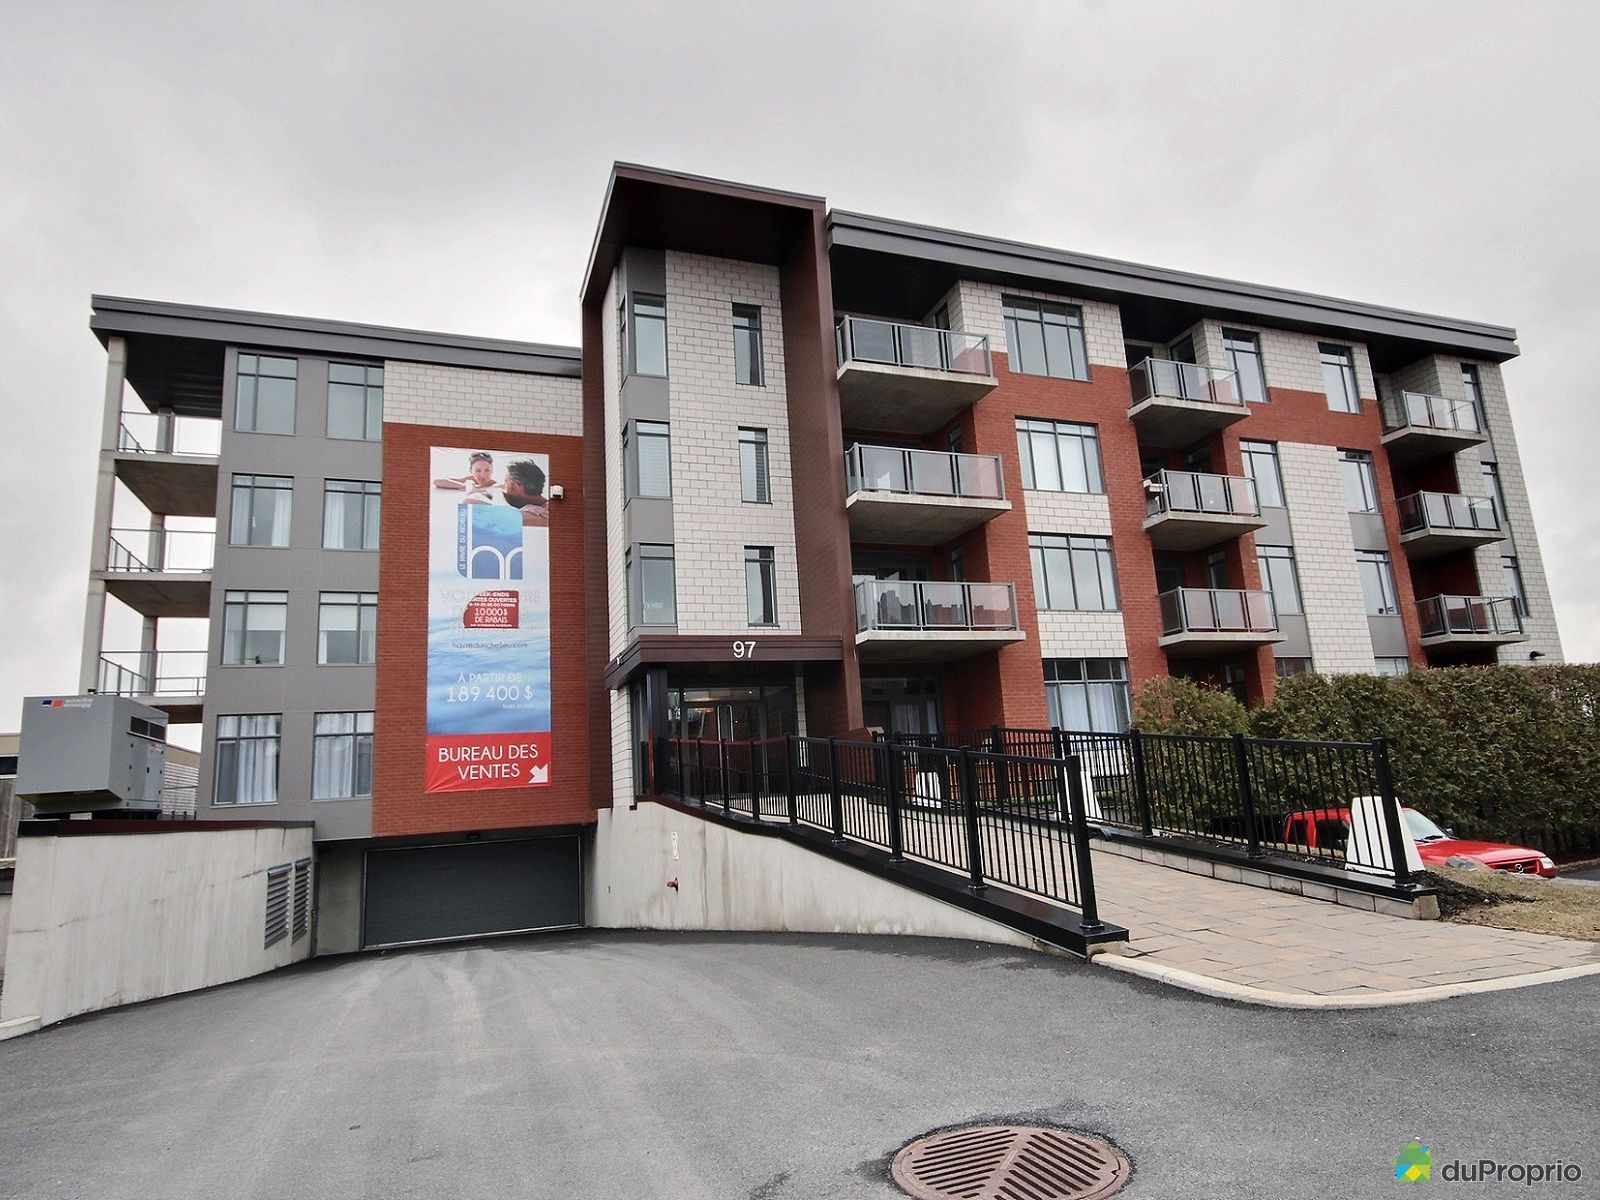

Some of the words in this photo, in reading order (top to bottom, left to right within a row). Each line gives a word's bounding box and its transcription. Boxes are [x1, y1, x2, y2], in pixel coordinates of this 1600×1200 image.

[733, 641, 756, 658] 97
[457, 672, 466, 684] À
[469, 673, 505, 683] PARTIR
[508, 673, 522, 683] DE
[446, 686, 480, 702] 189
[486, 685, 520, 701] 400
[523, 685, 533, 700] $
[438, 745, 502, 762] BUREAU
[508, 744, 539, 759] DES
[457, 763, 520, 780] VENTES
